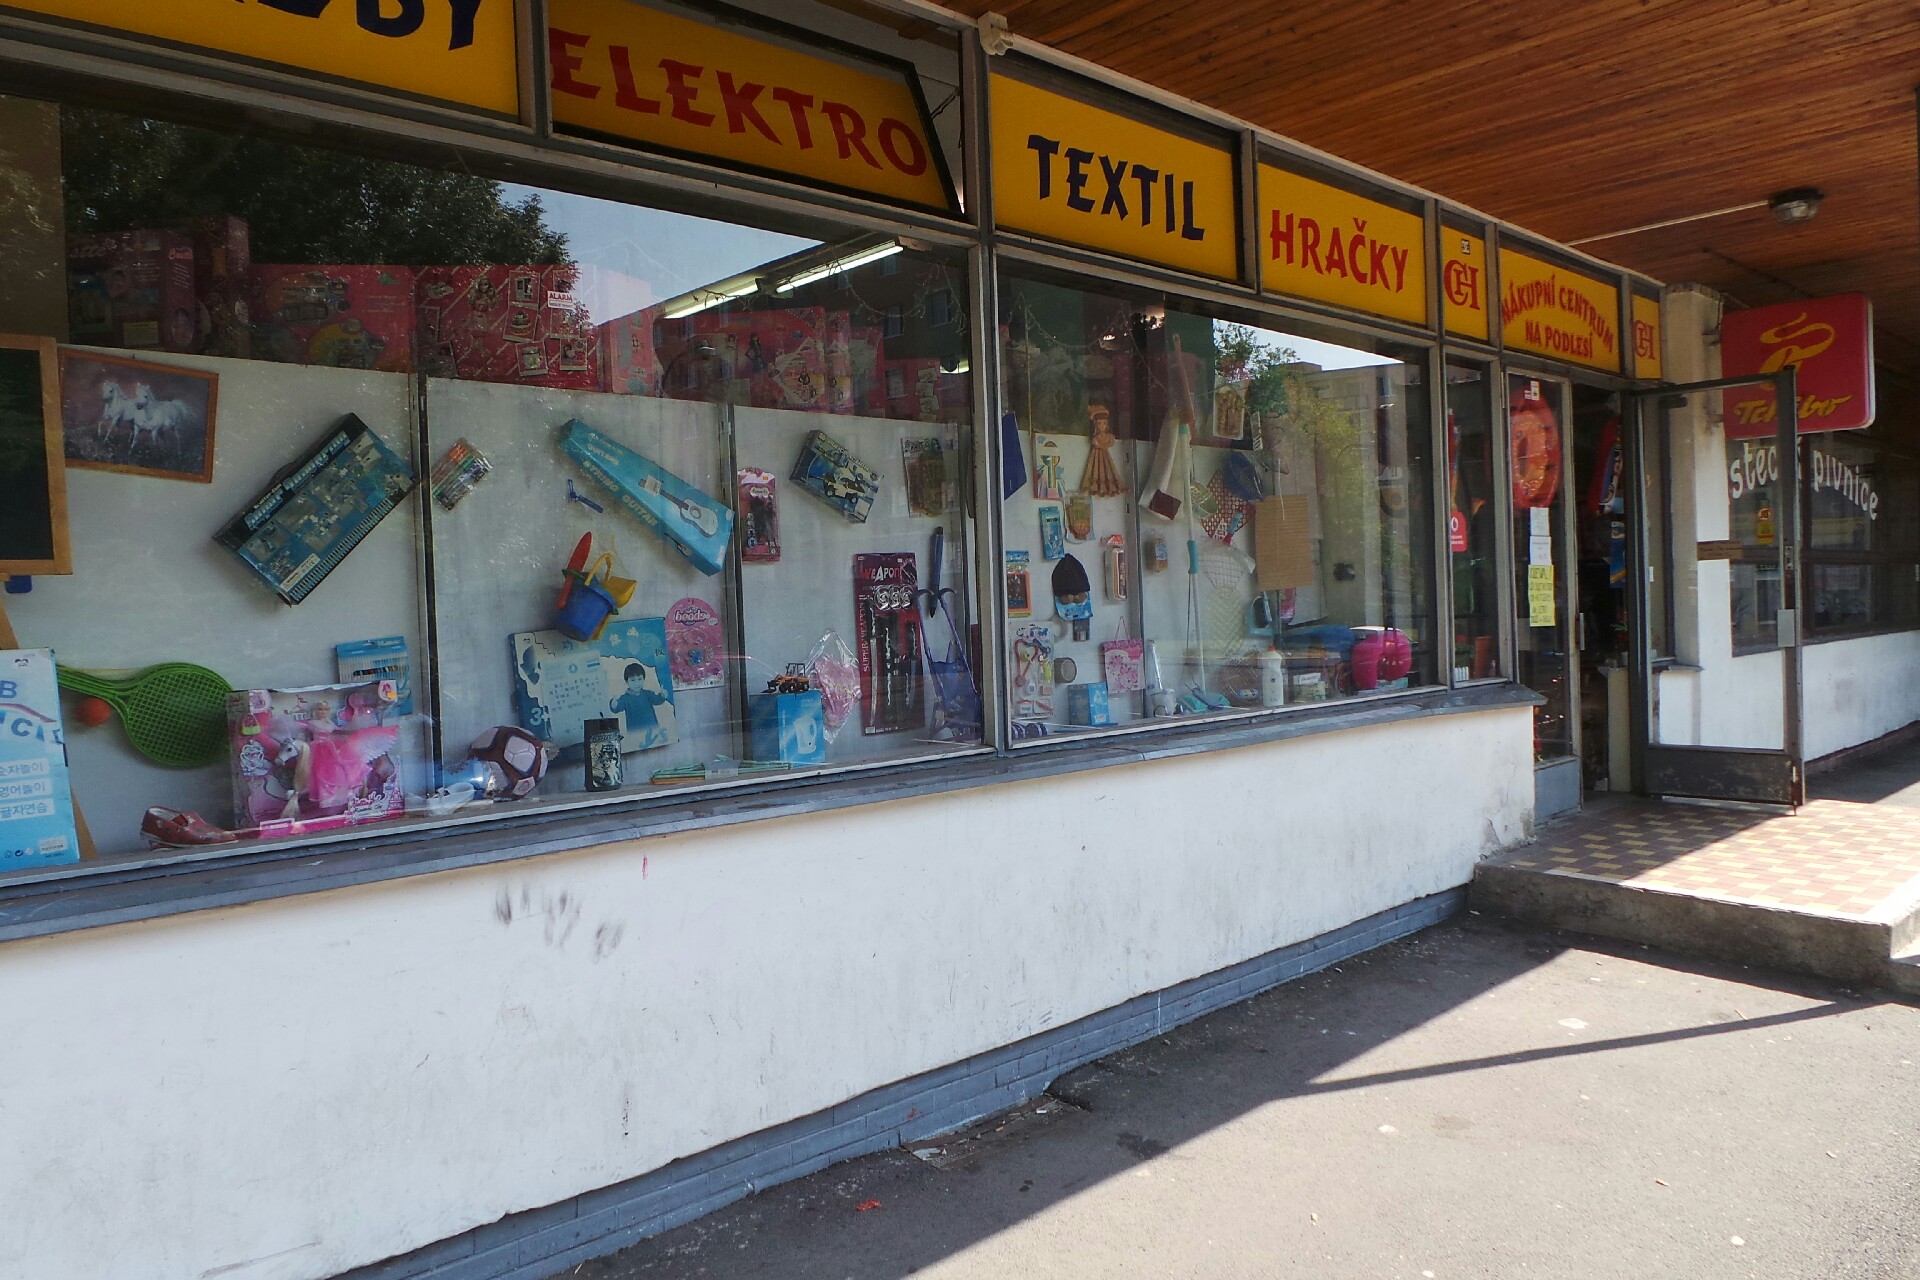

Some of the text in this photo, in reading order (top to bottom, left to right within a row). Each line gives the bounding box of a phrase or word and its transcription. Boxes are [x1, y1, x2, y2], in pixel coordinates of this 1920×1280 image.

[550, 27, 928, 177] ELEKTRO
[1027, 133, 1205, 241] TEXTIL
[1270, 209, 1408, 293] HRAČKY
[549, 291, 573, 302] ALARM
[1501, 272, 1614, 353] NÁKUPNÍ CENTRUM
[1525, 319, 1593, 359] NA PODLESÍ
[1813, 450, 1879, 521] pivnice
[674, 609, 706, 625] beads
